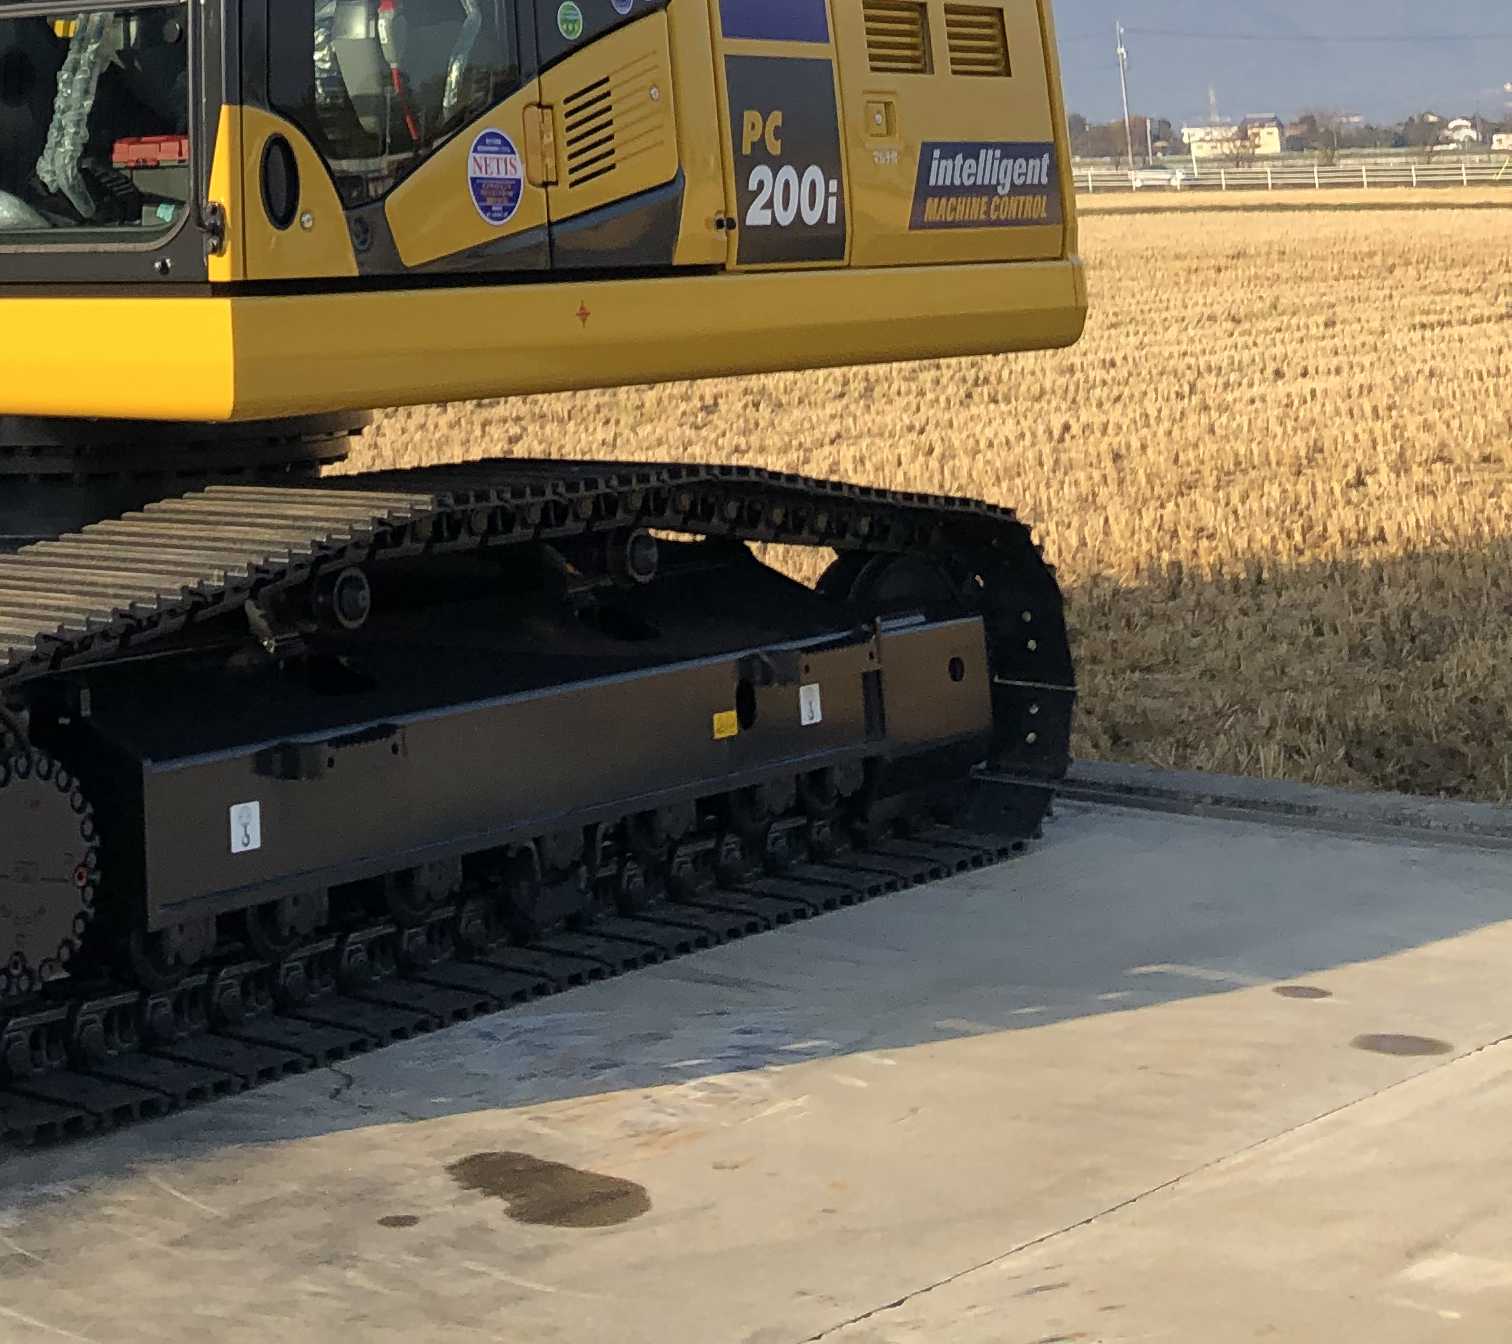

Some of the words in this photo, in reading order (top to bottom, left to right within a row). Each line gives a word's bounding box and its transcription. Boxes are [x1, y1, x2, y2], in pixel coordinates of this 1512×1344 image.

[741, 110, 783, 156] PC
[472, 156, 518, 175] NETIS
[928, 148, 1050, 196] intelligent
[745, 164, 838, 226] 200i
[924, 196, 988, 222] MACHINE
[990, 194, 1047, 220] CONTROL
